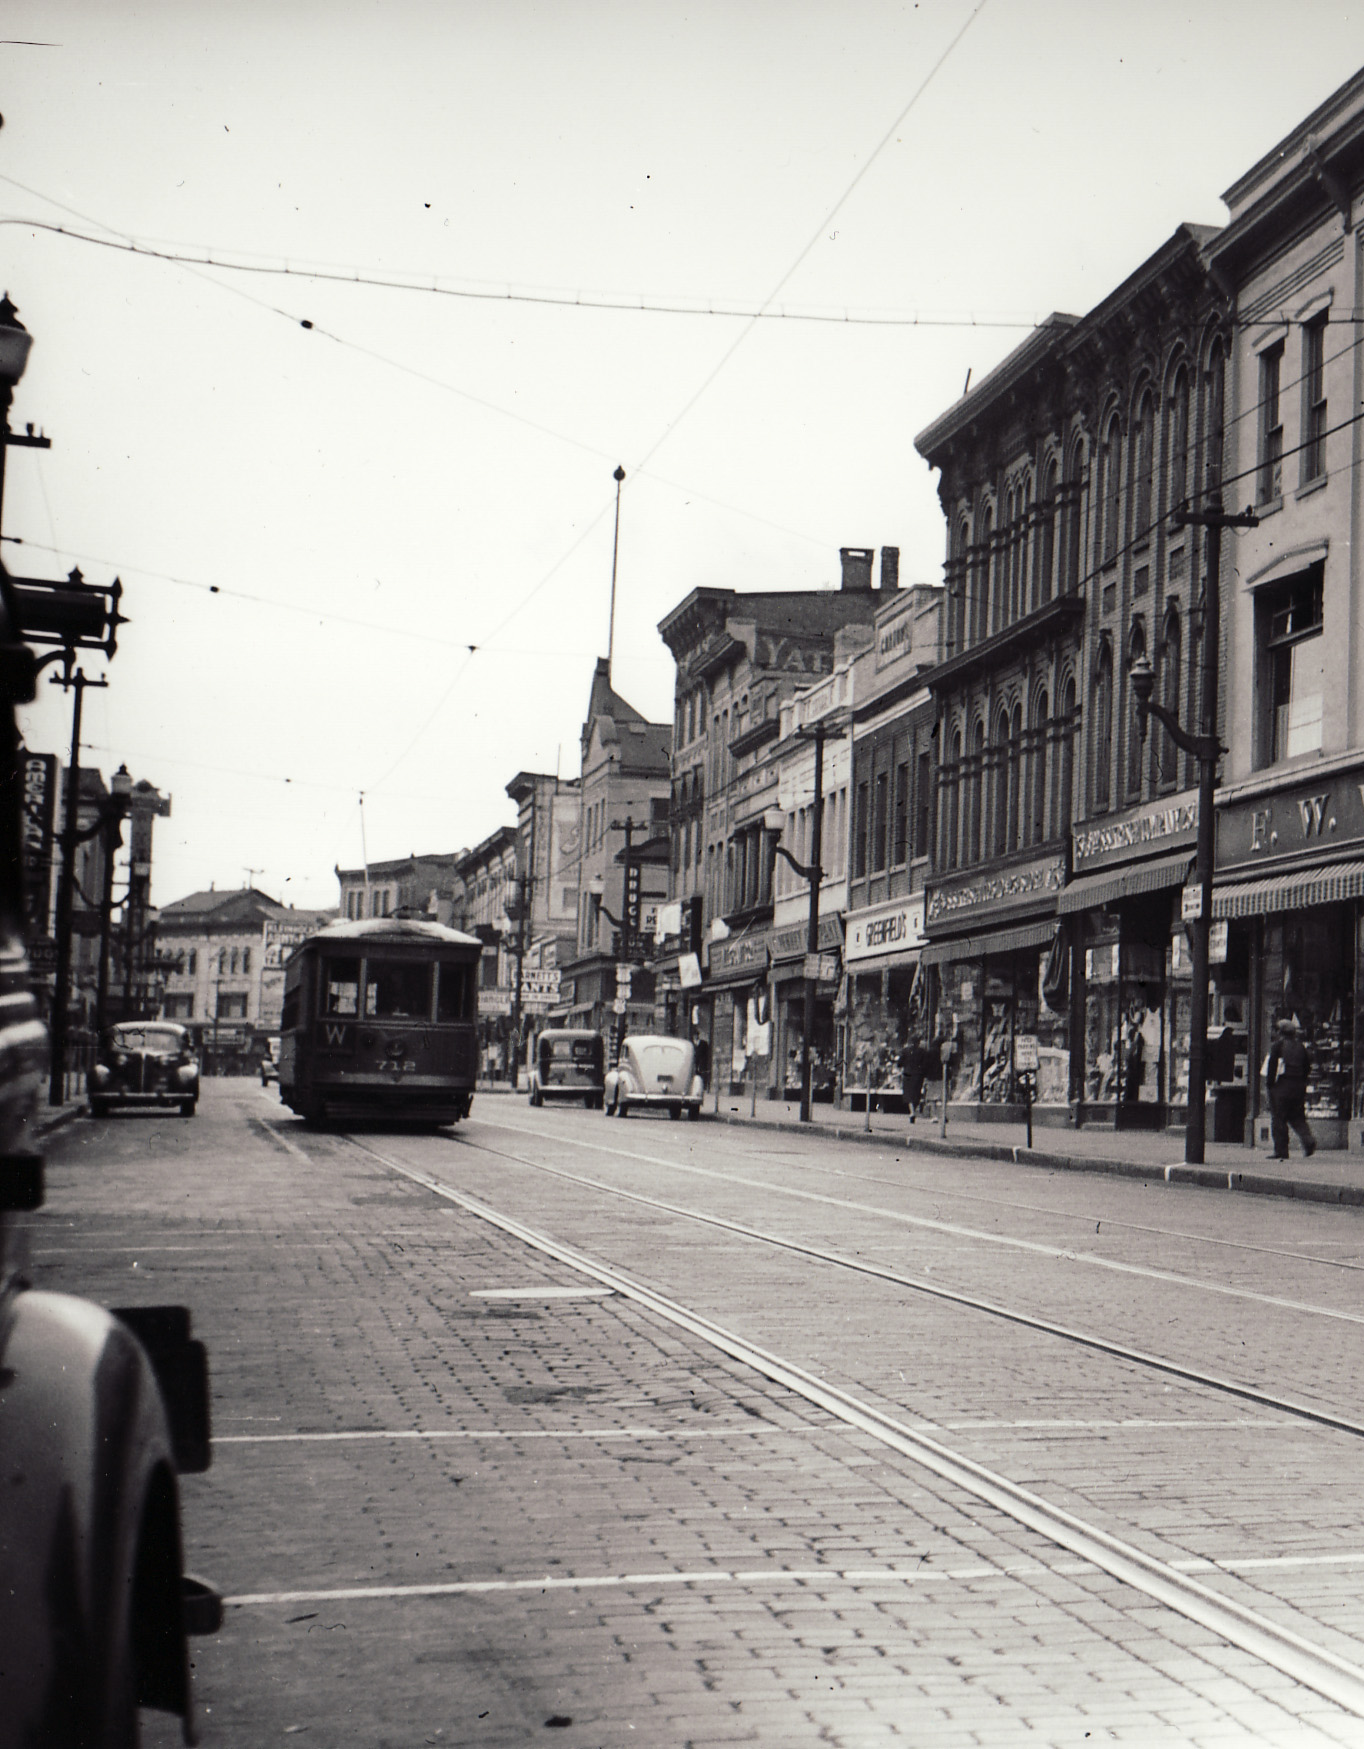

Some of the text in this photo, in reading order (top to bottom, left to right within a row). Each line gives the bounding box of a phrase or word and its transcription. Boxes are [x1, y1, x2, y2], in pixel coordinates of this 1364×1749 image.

[1249, 808, 1278, 851] F.
[1297, 794, 1338, 839] W.
[511, 982, 559, 993] ANTS
[325, 1024, 347, 1045] W
[375, 1060, 416, 1071] 712
